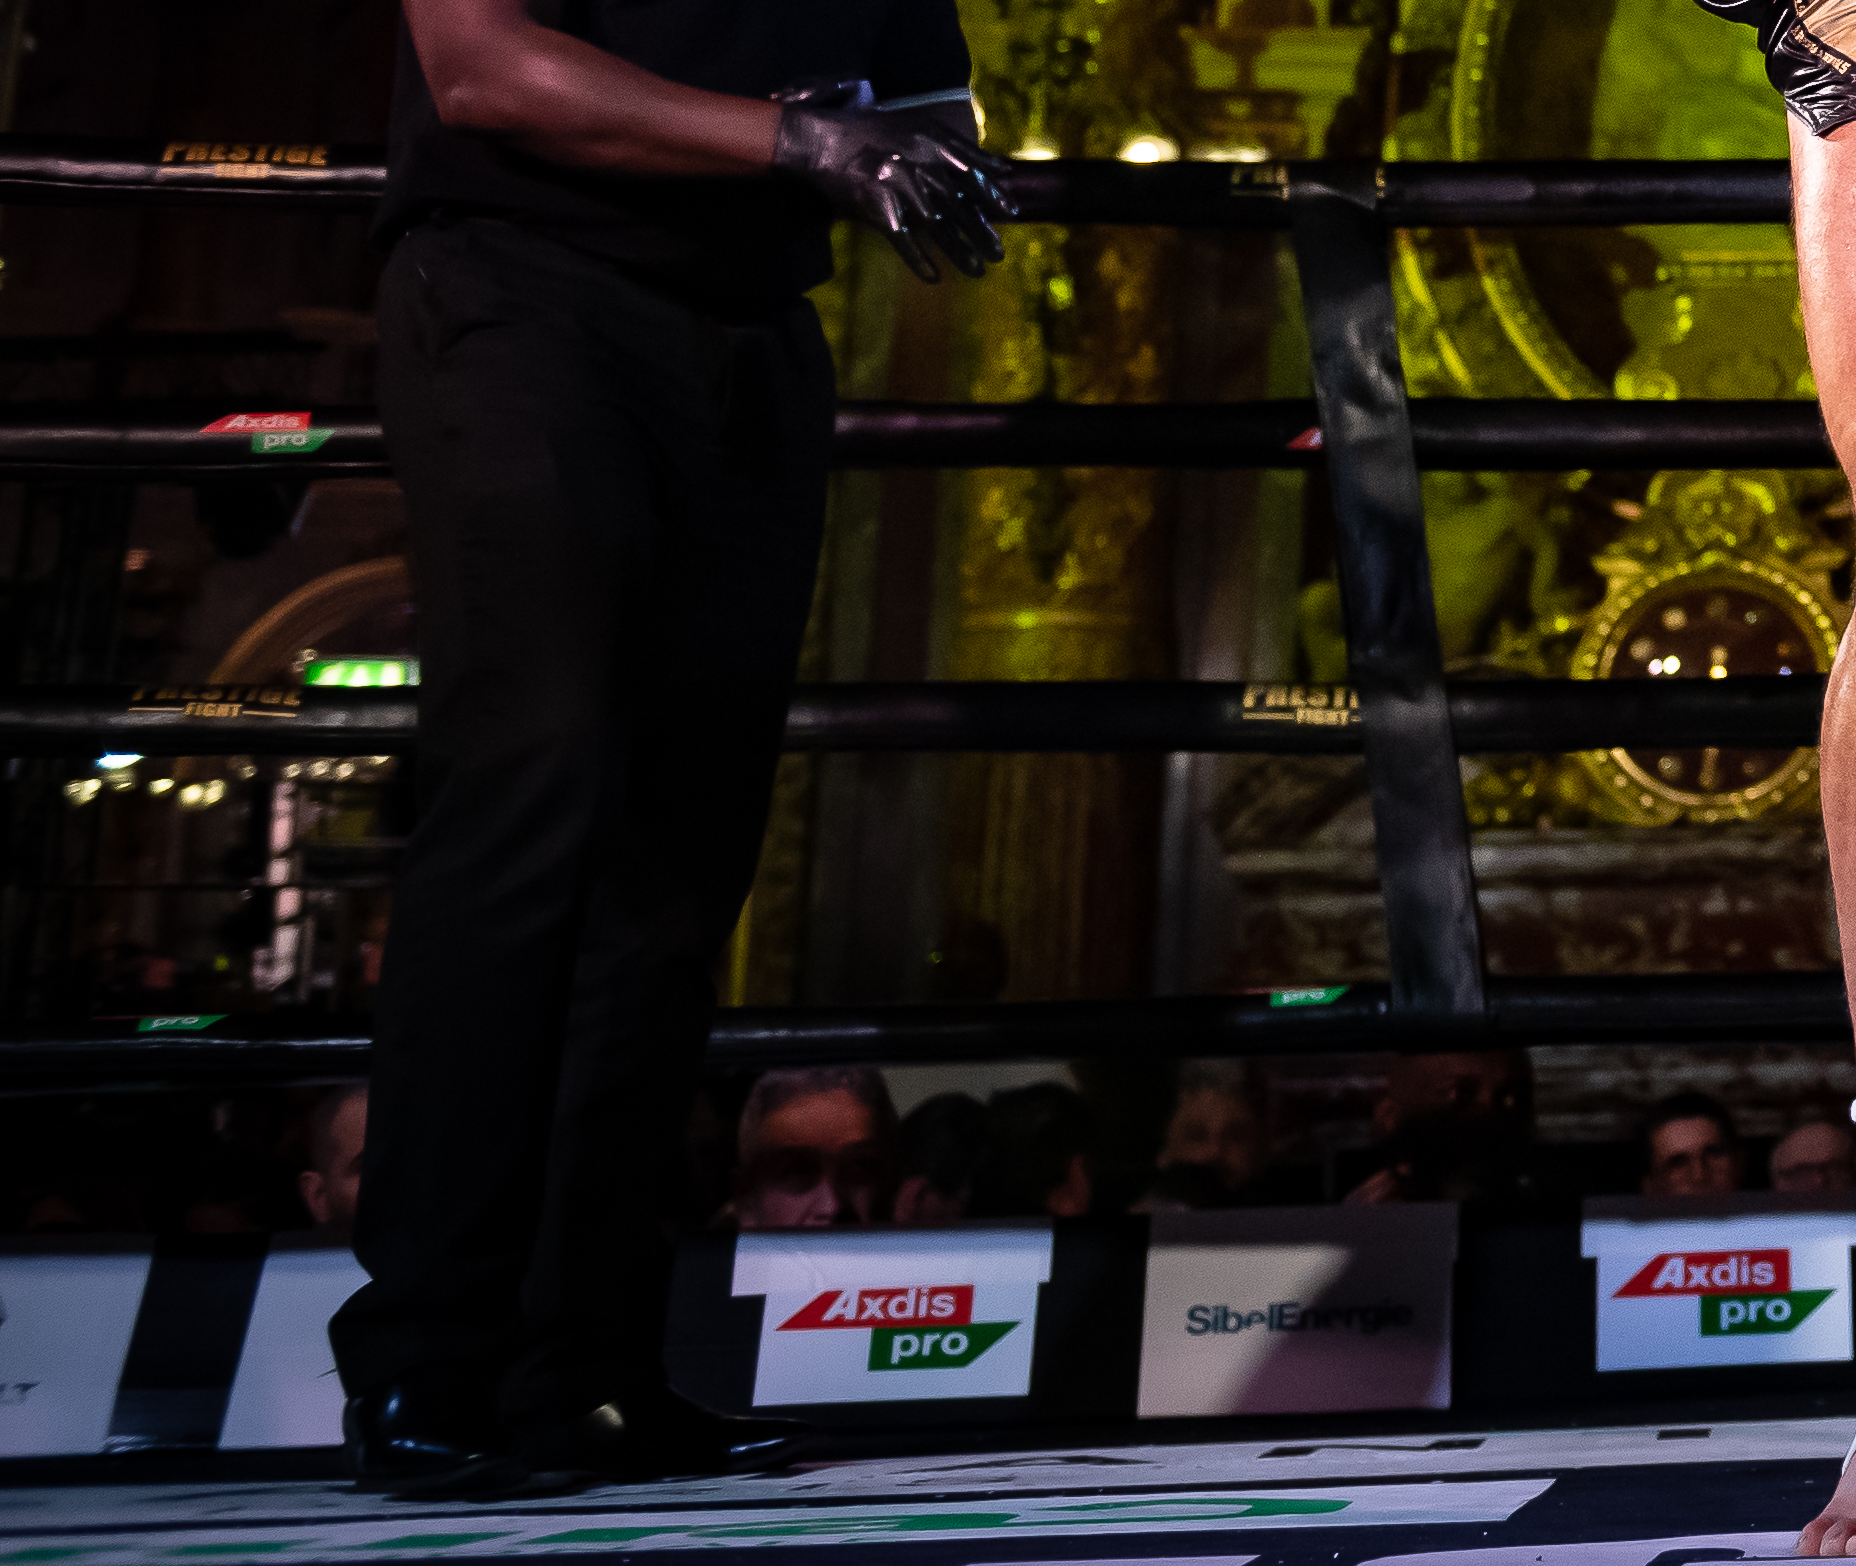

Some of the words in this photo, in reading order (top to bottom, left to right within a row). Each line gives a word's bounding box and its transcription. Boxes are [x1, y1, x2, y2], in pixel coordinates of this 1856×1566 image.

[262, 434, 308, 450] pro
[1650, 1255, 1777, 1290] Axdis
[820, 1286, 957, 1322] Axdis
[1719, 1298, 1792, 1331] pro
[890, 1331, 970, 1365] pro
